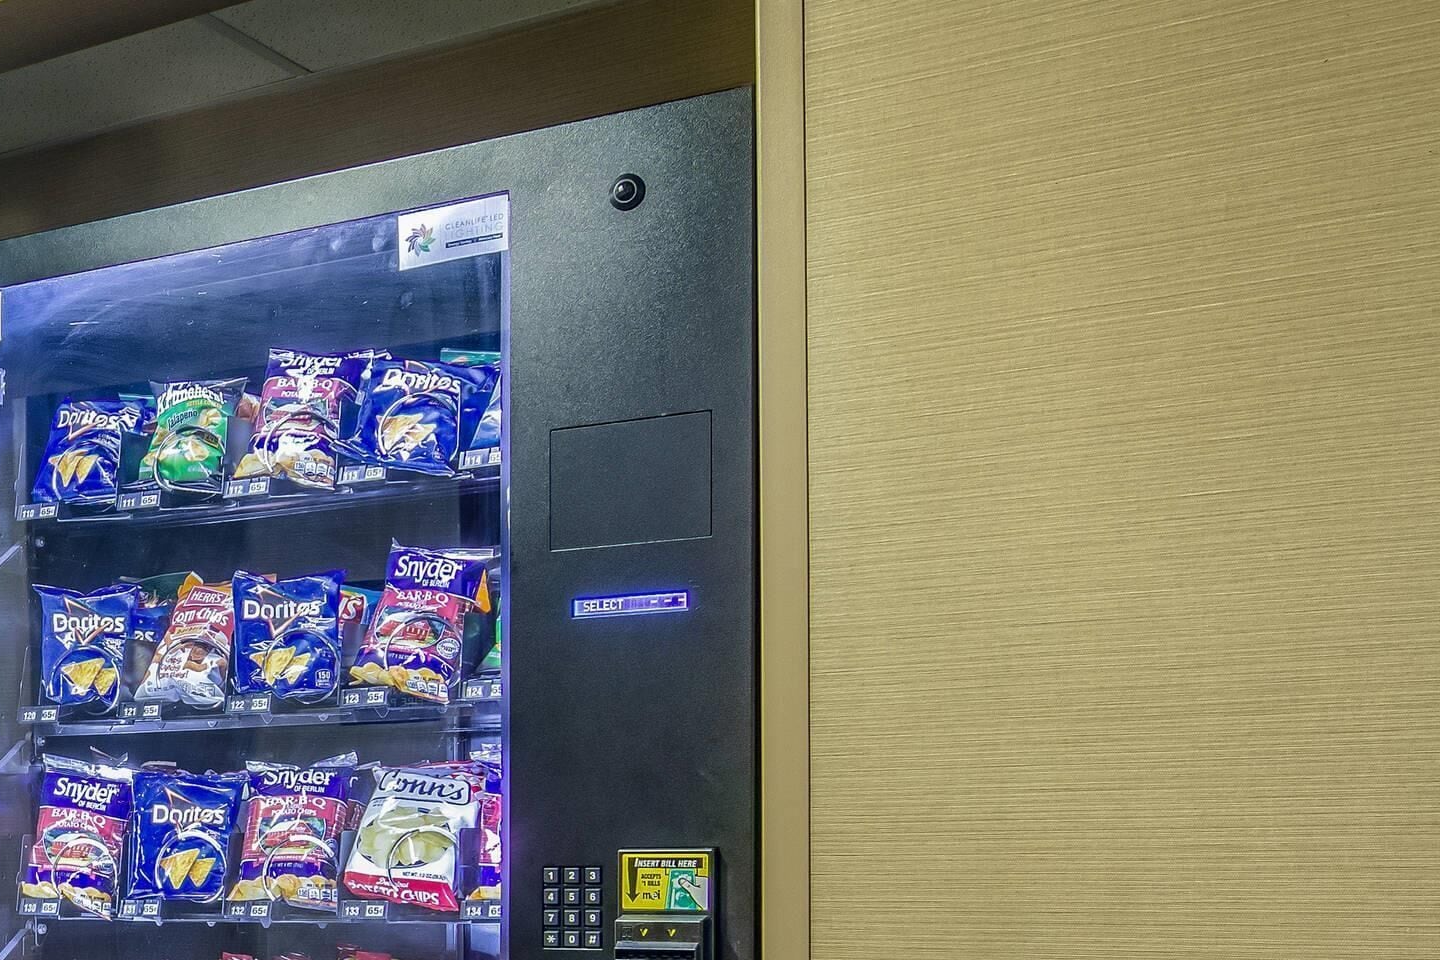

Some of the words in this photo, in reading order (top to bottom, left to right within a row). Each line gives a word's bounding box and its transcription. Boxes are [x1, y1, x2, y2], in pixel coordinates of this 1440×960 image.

[382, 369, 461, 392] Doritos
[58, 410, 121, 429] Doritos
[122, 498, 136, 508] 111
[22, 509, 35, 518] 110
[394, 555, 463, 583] Snyder
[243, 600, 320, 621] Doritos
[583, 598, 624, 612] SELECT
[52, 612, 125, 633] Doritos
[230, 701, 245, 710] 122
[345, 695, 360, 705] 123
[123, 707, 136, 717] 121
[263, 769, 336, 789] Snyder
[379, 769, 466, 801] Conn's
[53, 777, 120, 804] Snyder
[152, 804, 226, 825] Doritos
[634, 858, 660, 867] INSERT
[678, 859, 697, 867] HERE
[401, 889, 440, 905] CHIPS
[642, 889, 661, 900] mei
[231, 906, 245, 915] 132
[345, 906, 360, 916] 133
[466, 906, 481, 917] 134
